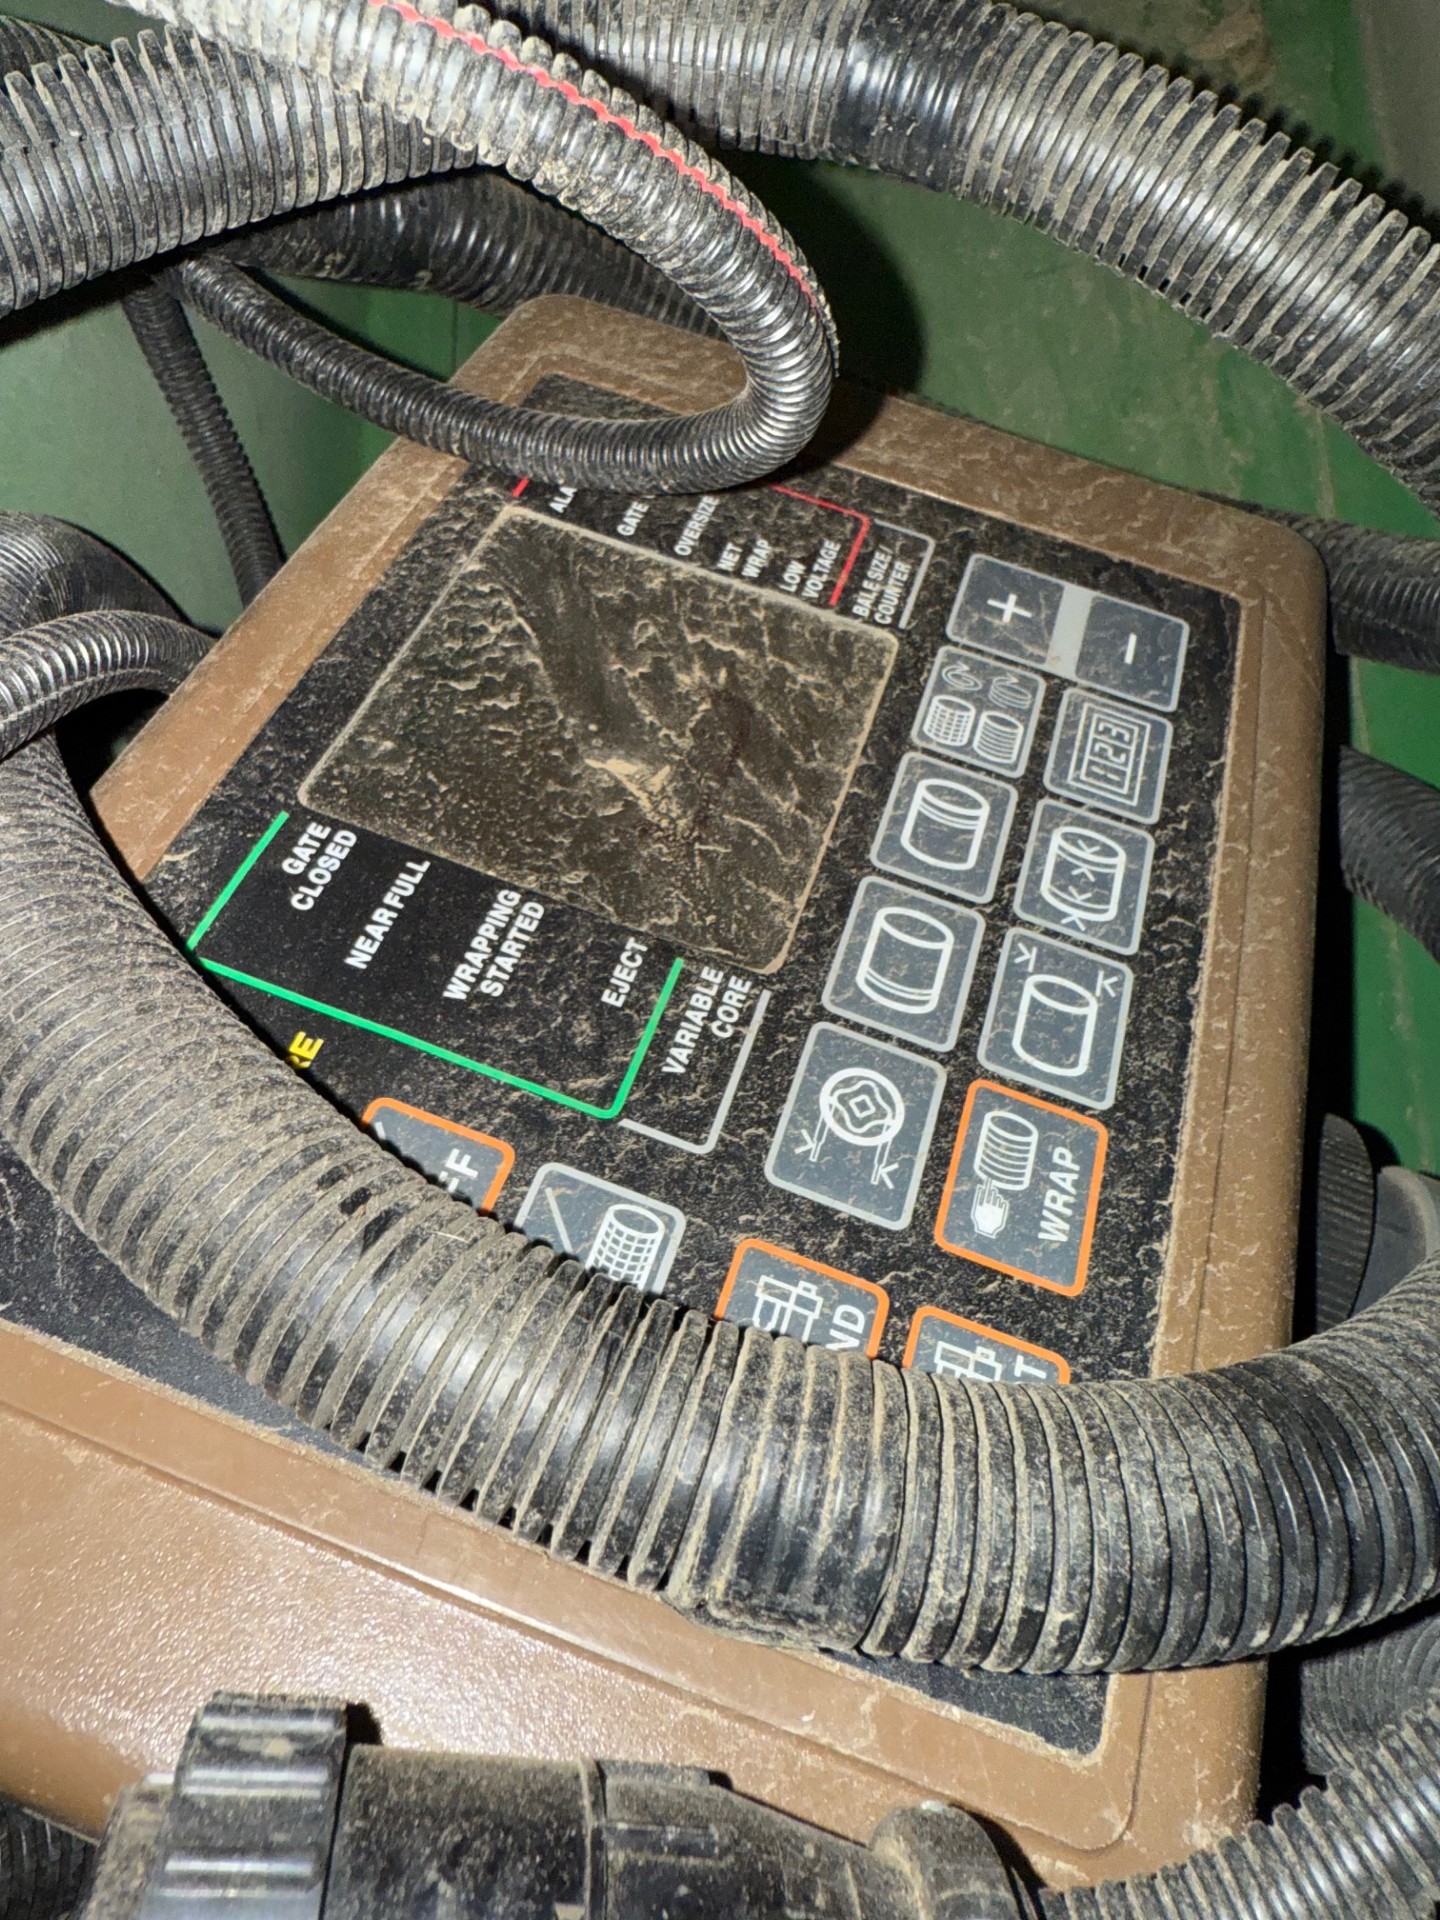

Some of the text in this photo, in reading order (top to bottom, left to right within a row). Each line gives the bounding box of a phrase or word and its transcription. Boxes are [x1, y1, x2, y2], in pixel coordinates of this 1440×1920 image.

[616, 501, 650, 536] GATE
[673, 495, 720, 556] OVERSIZE
[718, 542, 744, 571] NET
[741, 539, 773, 579] WRAP
[779, 560, 807, 593] LOW
[803, 540, 841, 599] VOLTAGE
[853, 578, 880, 618] BALE
[874, 561, 912, 625] COUNTER
[281, 822, 333, 876] GATE
[290, 829, 358, 912] CLOSED
[344, 859, 430, 970] NEAR FULL
[443, 889, 522, 1003] WRAPPING
[479, 900, 545, 999] STARTED
[602, 938, 649, 1008] EJECT
[662, 968, 724, 1074] VARIABLE
[714, 976, 752, 1039] CORE
[1038, 1147, 1083, 1242] WRAP
